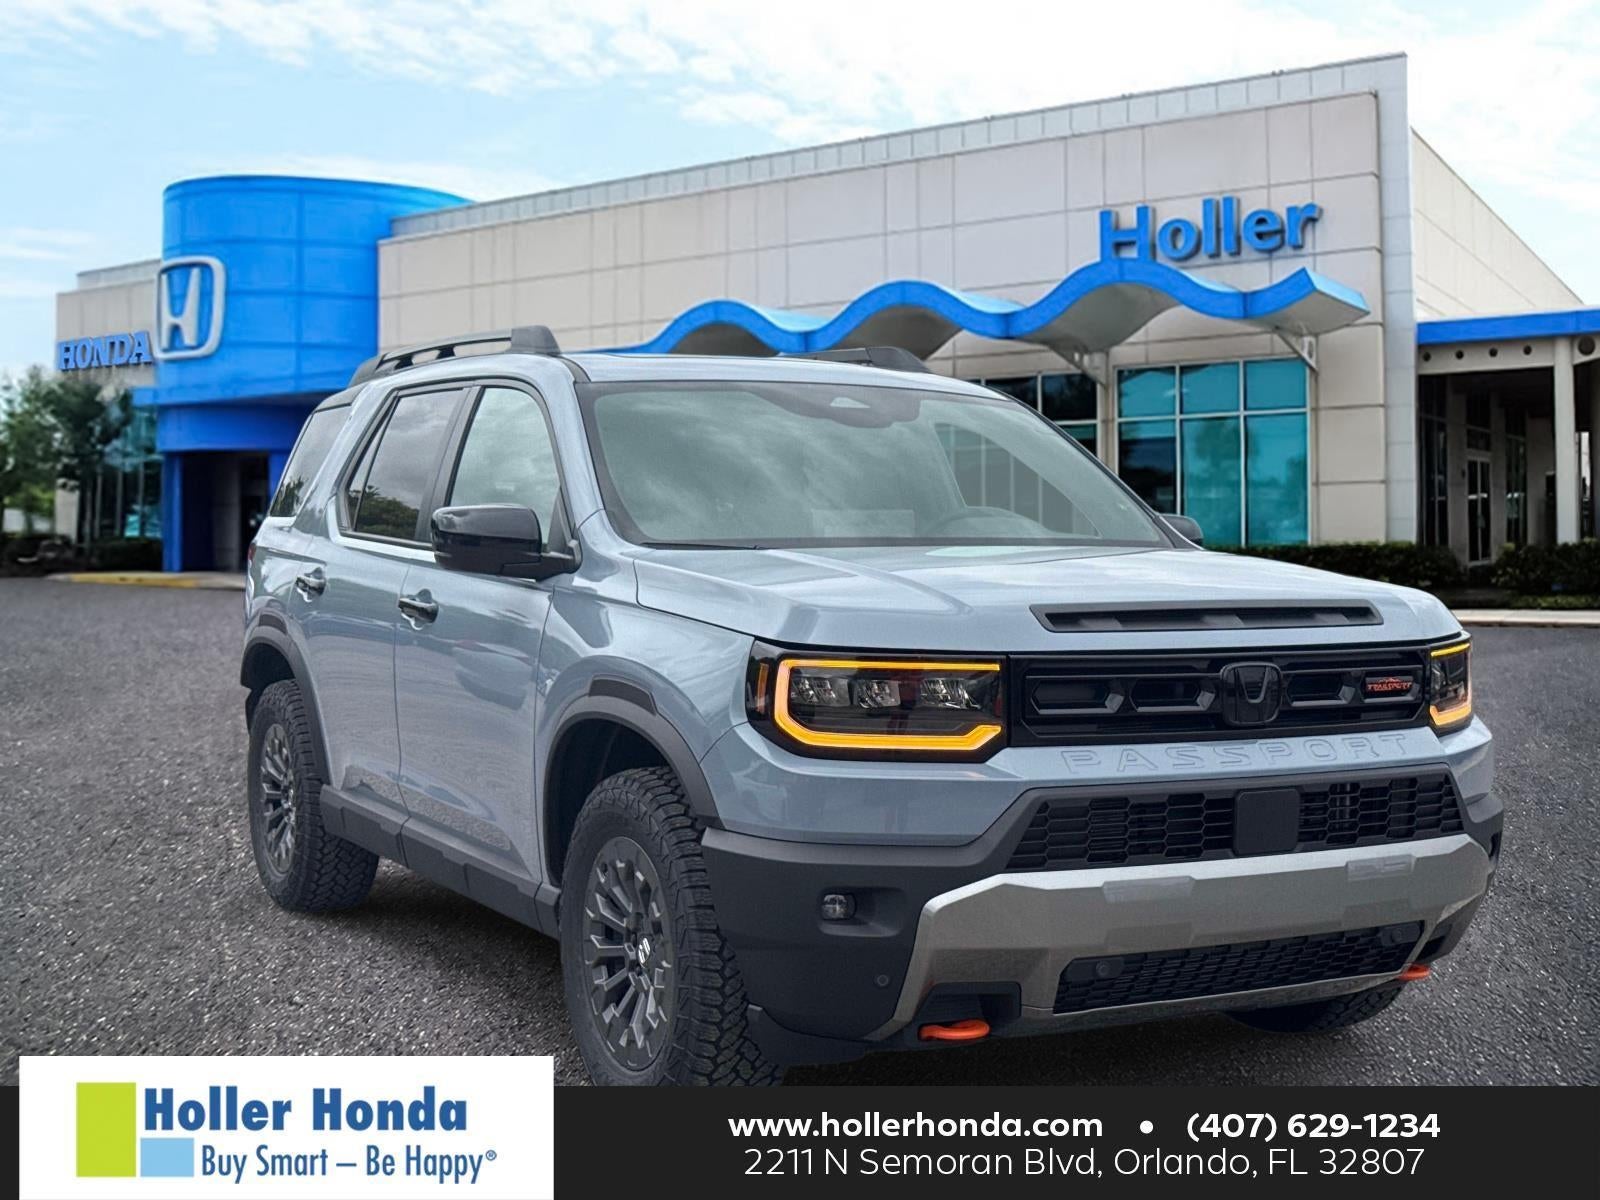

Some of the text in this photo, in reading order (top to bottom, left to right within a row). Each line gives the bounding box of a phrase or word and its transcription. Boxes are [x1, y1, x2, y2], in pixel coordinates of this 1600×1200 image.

[1099, 195, 1322, 262] Holler
[57, 330, 153, 371] HONDA
[1060, 734, 1407, 775] PASSPORT
